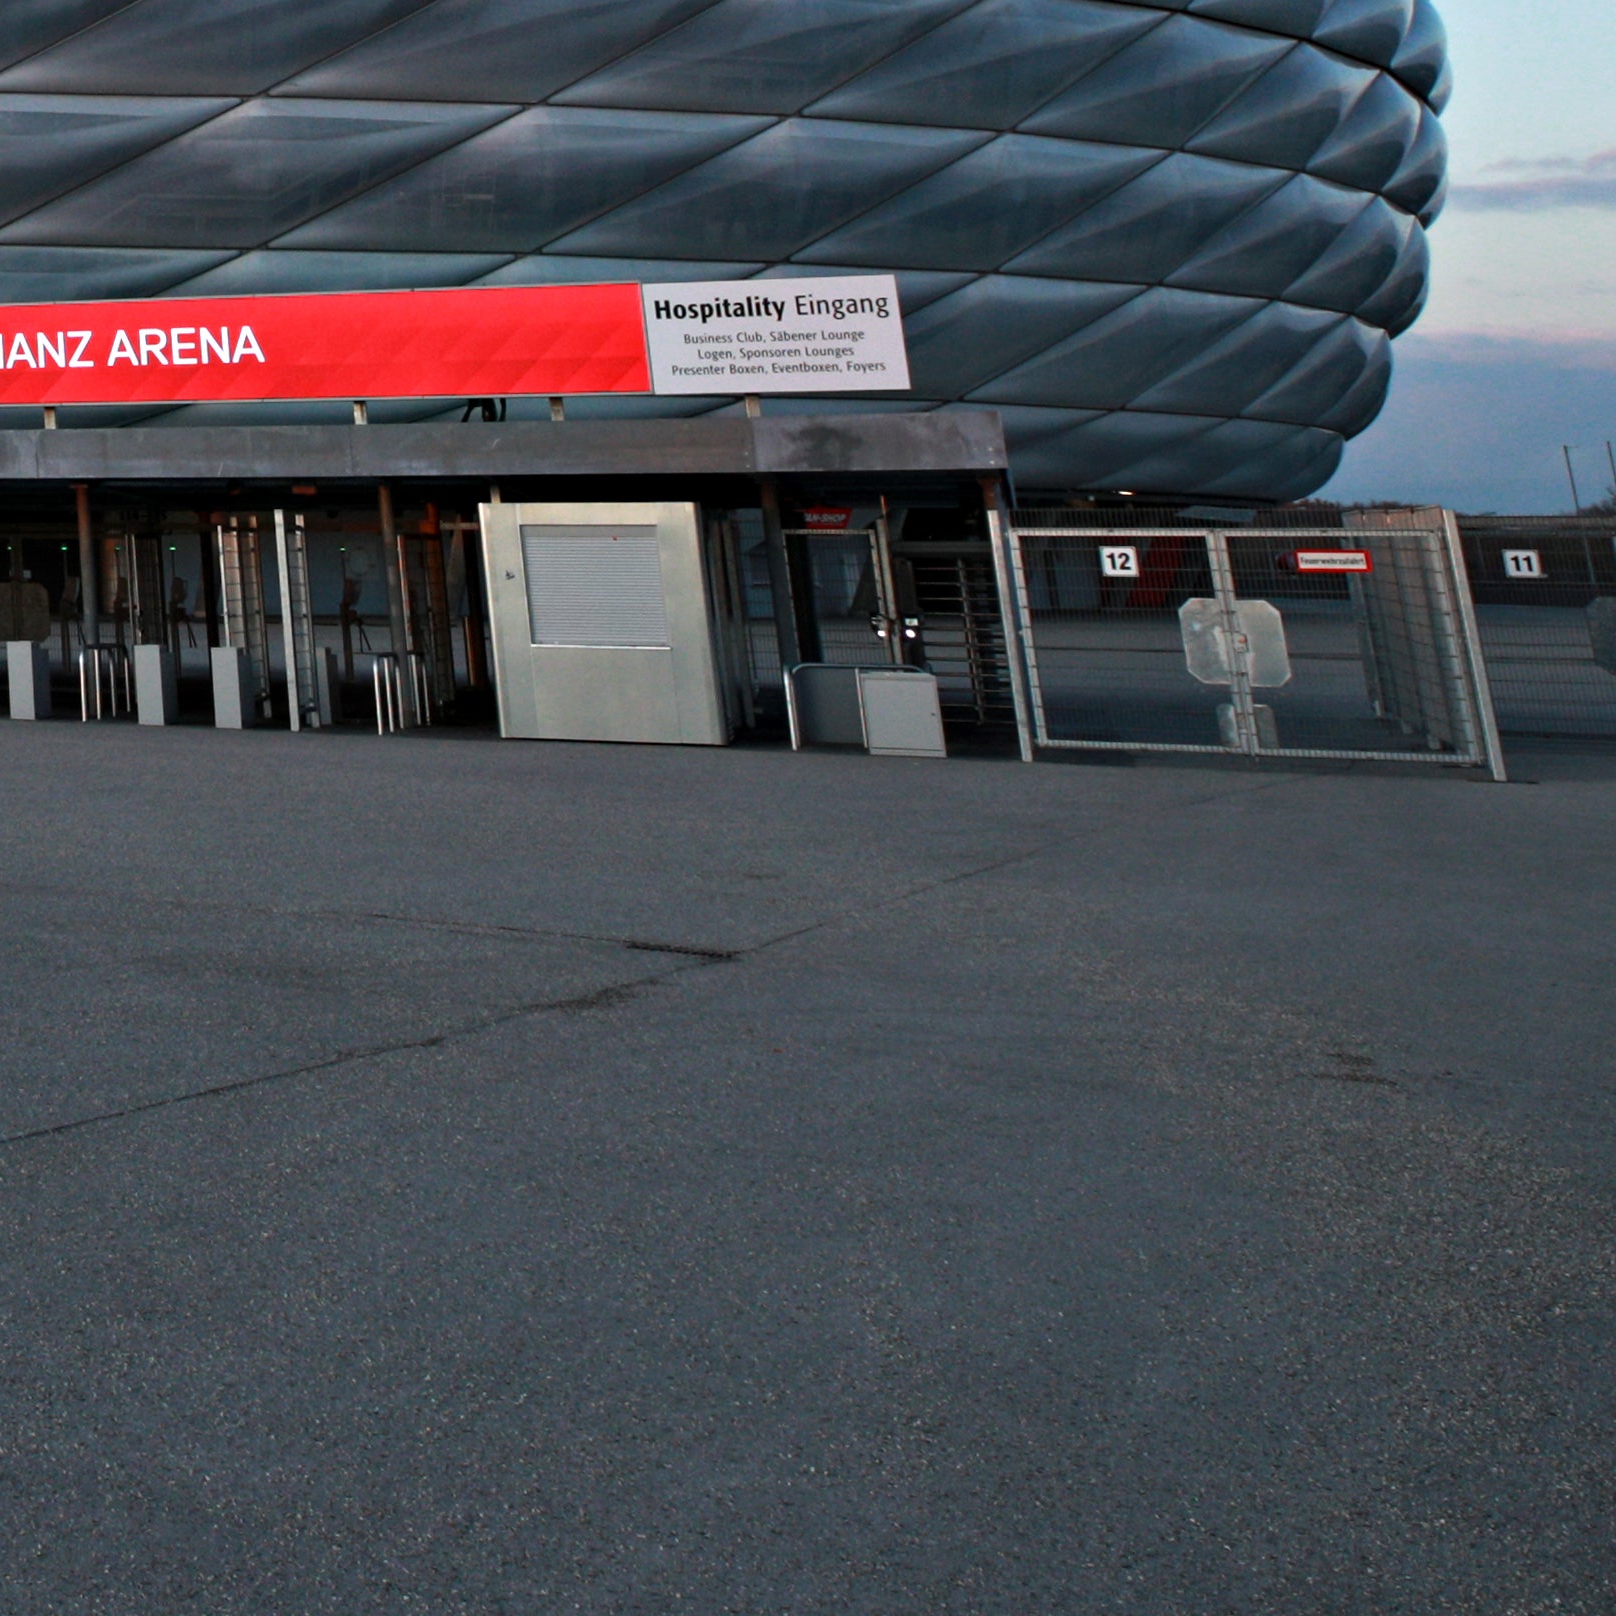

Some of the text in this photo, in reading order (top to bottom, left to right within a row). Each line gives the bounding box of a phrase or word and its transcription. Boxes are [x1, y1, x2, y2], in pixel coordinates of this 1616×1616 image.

[654, 294, 890, 322] Hospitality Eingang
[107, 325, 265, 367] ARENA
[683, 330, 865, 344] Business Club, Säbener Lounge
[697, 346, 855, 360] Logen, Sponsoren Lounges
[672, 360, 886, 376] Presenter Boxen, Eventboxen, Foyers
[1105, 551, 1132, 571] 12
[1510, 554, 1534, 573] 11
